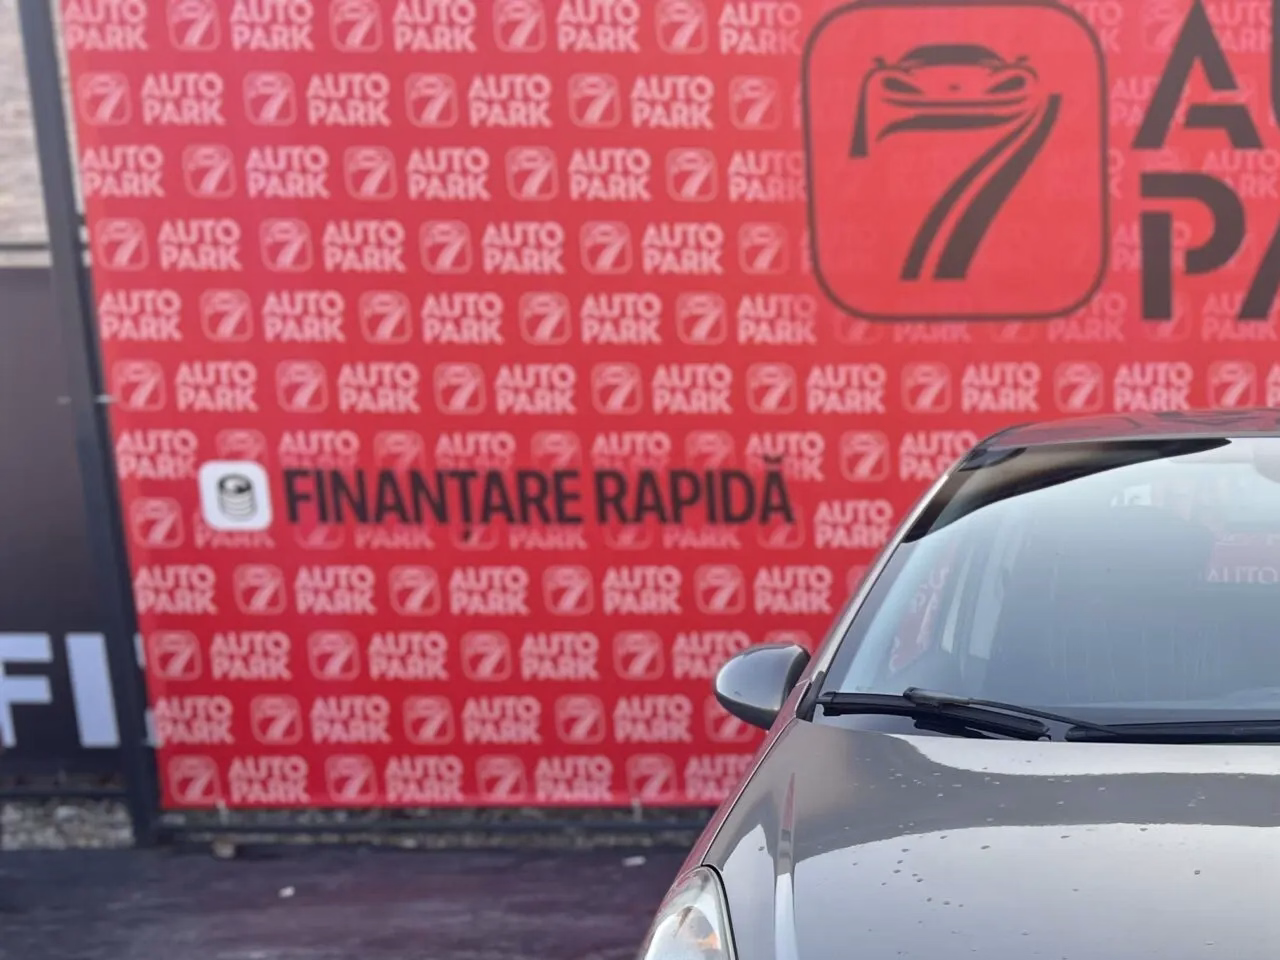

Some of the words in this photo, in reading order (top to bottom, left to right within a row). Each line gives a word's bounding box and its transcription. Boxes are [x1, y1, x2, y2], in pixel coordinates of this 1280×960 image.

[64, 0, 147, 25] AUTO
[230, 0, 313, 24] AUTO
[393, 0, 476, 26] AUTO
[557, 0, 640, 25] AUTO
[66, 24, 147, 50] PARK
[231, 23, 313, 50] PARK
[394, 25, 476, 51] PARK
[558, 24, 639, 51] PARK
[141, 72, 223, 100] AUTO
[306, 73, 390, 99] AUTO
[468, 74, 551, 101] AUTO
[631, 76, 714, 101] AUTO
[142, 99, 224, 124] PARK
[308, 98, 390, 125] PARK
[470, 100, 551, 126] PARK
[632, 100, 713, 128] PARK
[80, 145, 163, 172] AUTO
[246, 146, 328, 173] AUTO
[406, 148, 489, 174] AUTO
[569, 148, 651, 175] AUTO
[83, 171, 164, 197] PARK
[247, 172, 329, 197] PARK
[408, 173, 490, 199] PARK
[570, 174, 650, 200] PARK
[158, 219, 240, 246] AUTO
[323, 220, 405, 248] AUTO
[482, 222, 564, 249] AUTO
[642, 223, 723, 249] AUTO
[160, 245, 241, 270] PARK
[324, 247, 405, 271] PARK
[484, 248, 564, 273] PARK
[643, 248, 722, 273] PARK
[97, 290, 181, 317] AUTO
[262, 291, 344, 317] AUTO
[421, 293, 503, 319] AUTO
[581, 293, 662, 320] AUTO
[99, 316, 181, 340] PARK
[264, 316, 345, 341] PARK
[423, 318, 502, 343] PARK
[582, 319, 661, 343] PARK
[175, 361, 257, 388] AUTO
[338, 362, 419, 388] AUTO
[495, 364, 576, 390] AUTO
[652, 364, 732, 389] AUTO
[807, 364, 886, 390] AUTO
[962, 363, 1041, 388] AUTO
[1114, 362, 1192, 388] AUTO
[177, 387, 257, 411] PARK
[339, 387, 420, 412] PARK
[496, 389, 575, 413] PARK
[653, 388, 731, 413] PARK
[807, 389, 885, 413] PARK
[962, 387, 1038, 411] PARK
[115, 430, 198, 456] AUTO
[278, 430, 360, 457] AUTO
[435, 432, 516, 459] AUTO
[591, 431, 671, 459] AUTO
[745, 432, 825, 458] AUTO
[594, 456, 795, 525] RAPIDĂ
[133, 565, 215, 590] AUTO
[295, 566, 375, 591] AUTO
[449, 567, 528, 592] AUTO
[602, 566, 682, 591] AUTO
[754, 566, 832, 591] AUTO
[135, 589, 216, 613] PARK
[296, 590, 375, 613] PARK
[450, 591, 528, 614] PARK
[604, 590, 681, 613] PARK
[755, 590, 831, 613] PARK
[210, 631, 290, 657] AUTO
[520, 632, 599, 657] AUTO
[211, 656, 291, 679] PARK
[521, 656, 598, 679] PARK
[310, 696, 390, 721] AUTO
[613, 695, 692, 721] AUTO
[312, 720, 390, 742] PARK
[614, 720, 691, 742] PARK
[228, 756, 308, 781] AUTO
[228, 780, 307, 803] PARK
